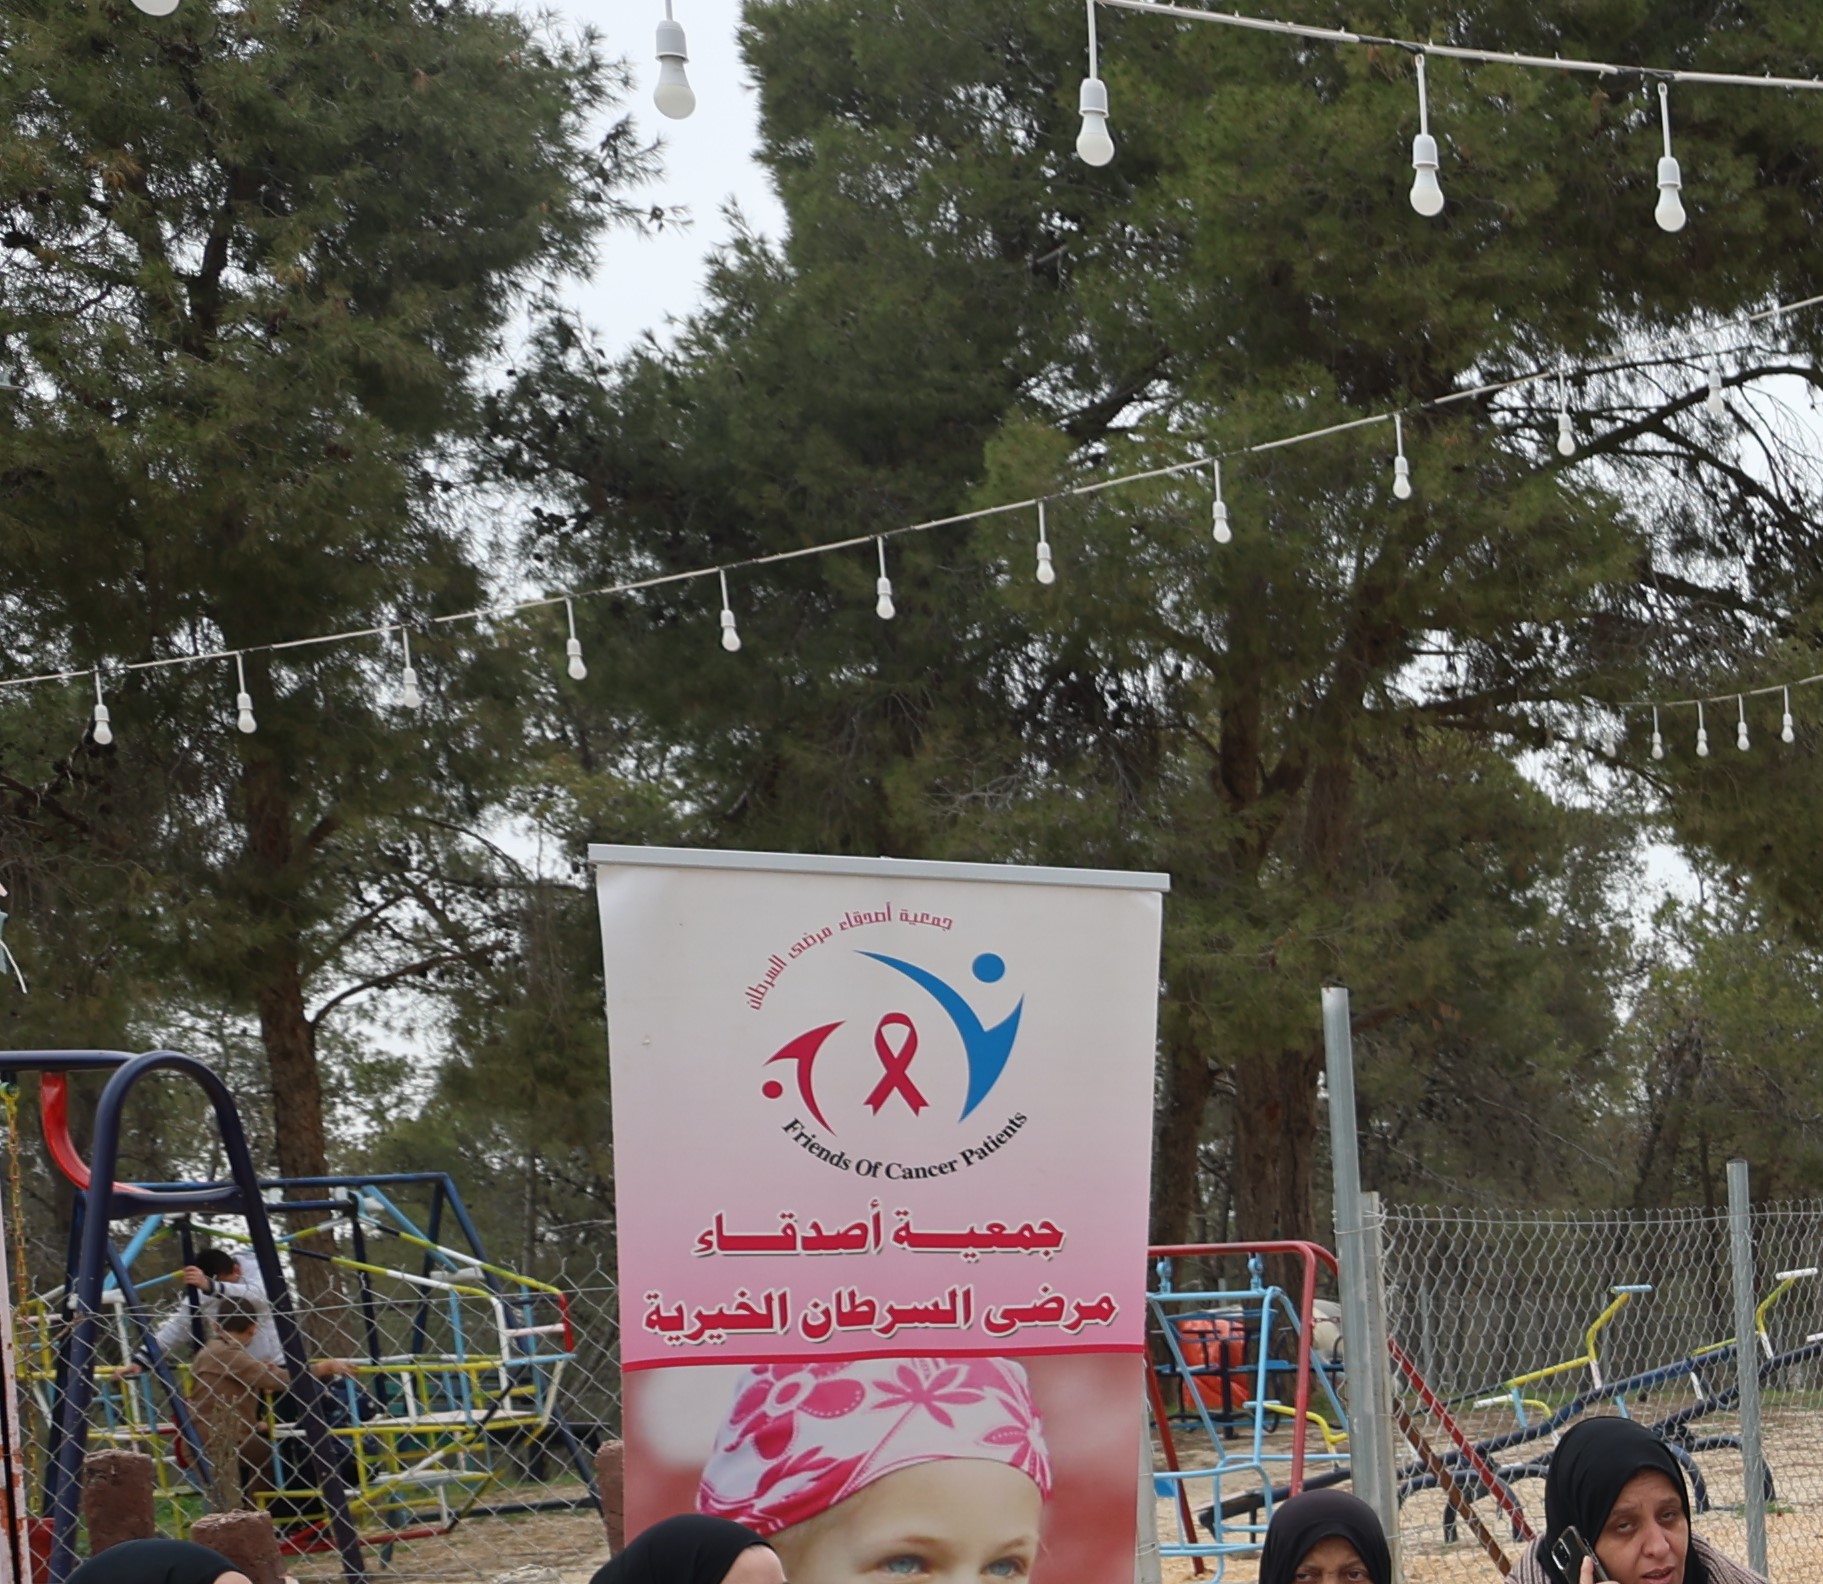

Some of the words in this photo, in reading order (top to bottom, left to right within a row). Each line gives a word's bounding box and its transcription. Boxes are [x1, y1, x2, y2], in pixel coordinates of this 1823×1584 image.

[788, 926, 833, 959] مرضى
[838, 901, 892, 931] أصدقاء
[899, 908, 953, 932] جمعية
[745, 954, 788, 1011] السرطان
[782, 1118, 851, 1171] Friends
[855, 1158, 882, 1178] Of
[884, 1159, 958, 1180] Cancer
[959, 1112, 1028, 1166] Patients
[691, 1199, 884, 1257] أصدقاء
[891, 1205, 1066, 1263] جمعية
[641, 1287, 790, 1346] الخيرية
[799, 1286, 974, 1343] السرطان
[982, 1282, 1118, 1339] مرضى
